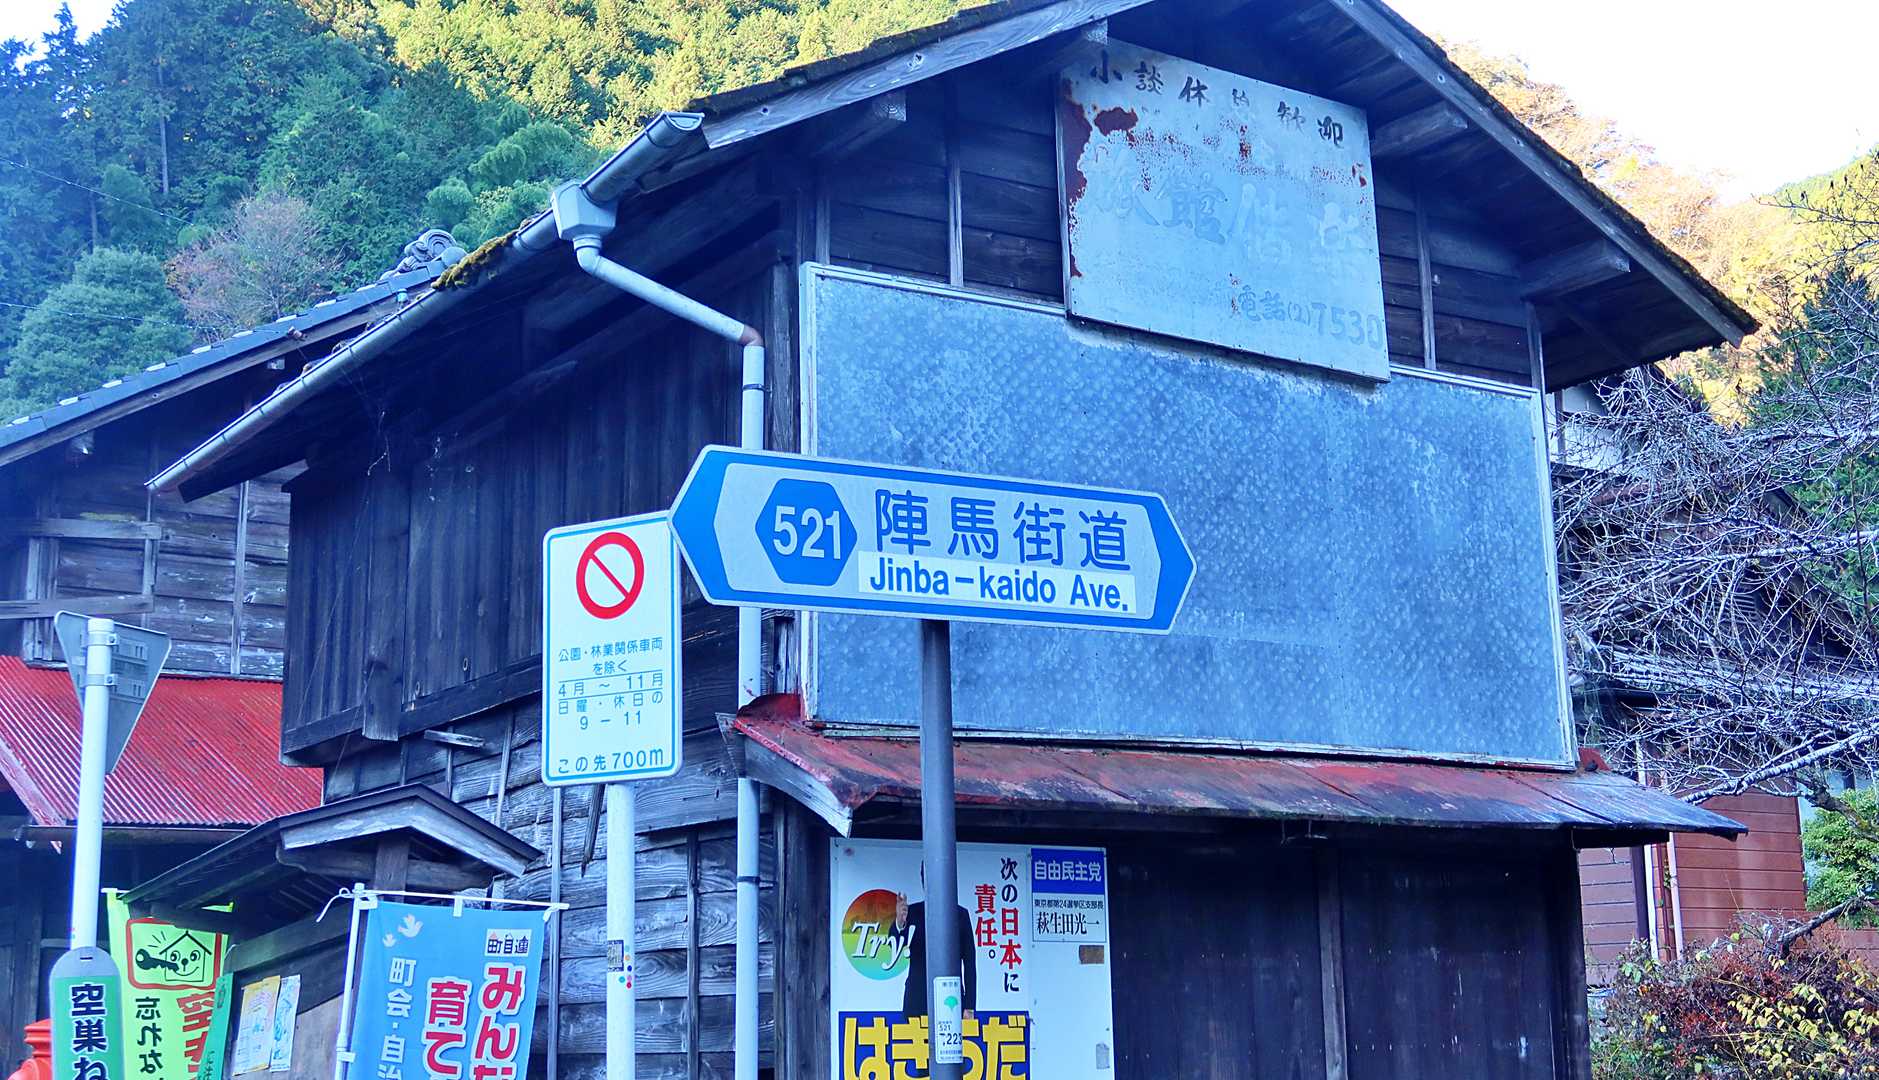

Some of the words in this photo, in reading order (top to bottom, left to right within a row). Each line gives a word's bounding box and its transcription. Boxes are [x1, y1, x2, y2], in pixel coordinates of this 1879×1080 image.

[771, 504, 841, 561] 521
[874, 487, 1131, 572] 陣馬街道
[1068, 573, 1128, 612] Ave.
[558, 636, 663, 663] 公園・林業関係車両
[592, 659, 628, 676] を除く
[558, 747, 664, 774] この先700m
[1034, 860, 1102, 882] 自由民主党
[1000, 857, 1022, 993] 次の日本に
[1036, 911, 1100, 936] 萩生田光一
[850, 921, 916, 971] Try!
